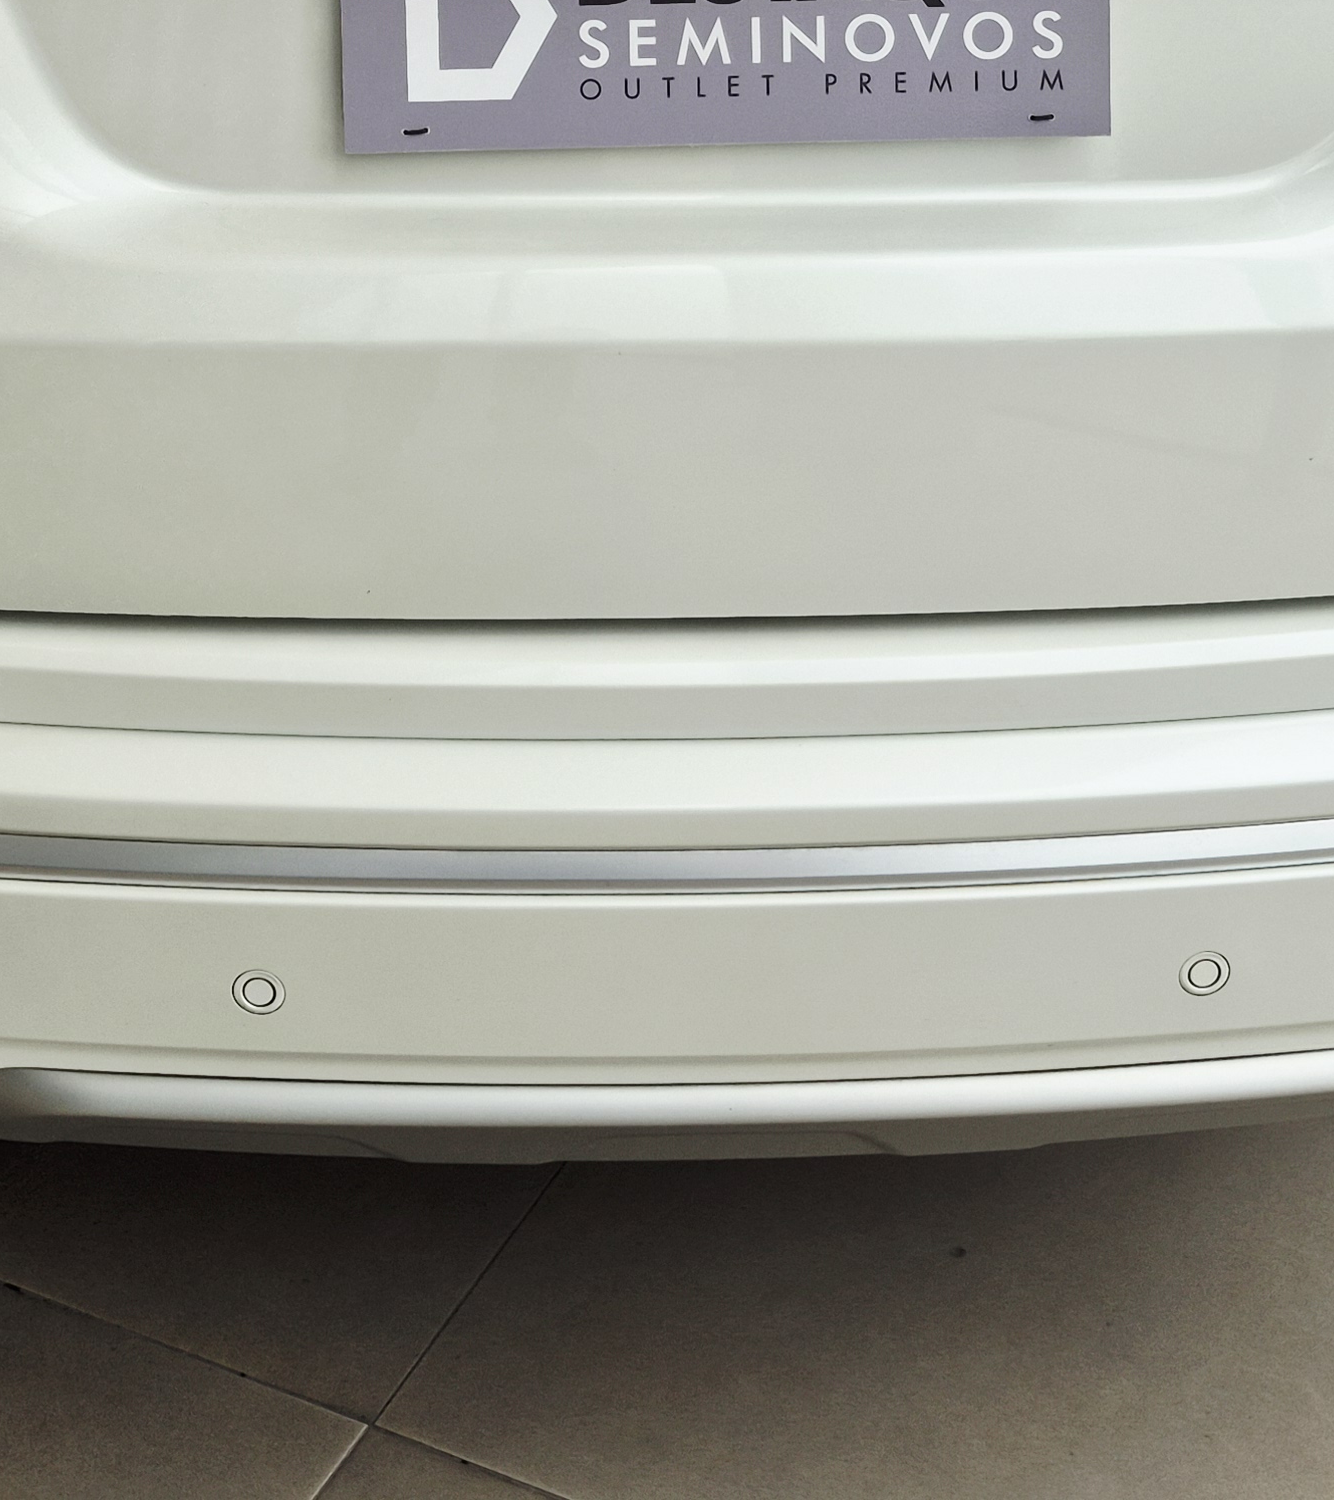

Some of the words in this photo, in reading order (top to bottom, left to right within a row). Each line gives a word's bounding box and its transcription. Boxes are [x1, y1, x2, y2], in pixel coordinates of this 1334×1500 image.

[578, 9, 1065, 70] SEMINOVOS
[579, 73, 776, 101] OUTLET
[825, 68, 1065, 96] PREMIUM
